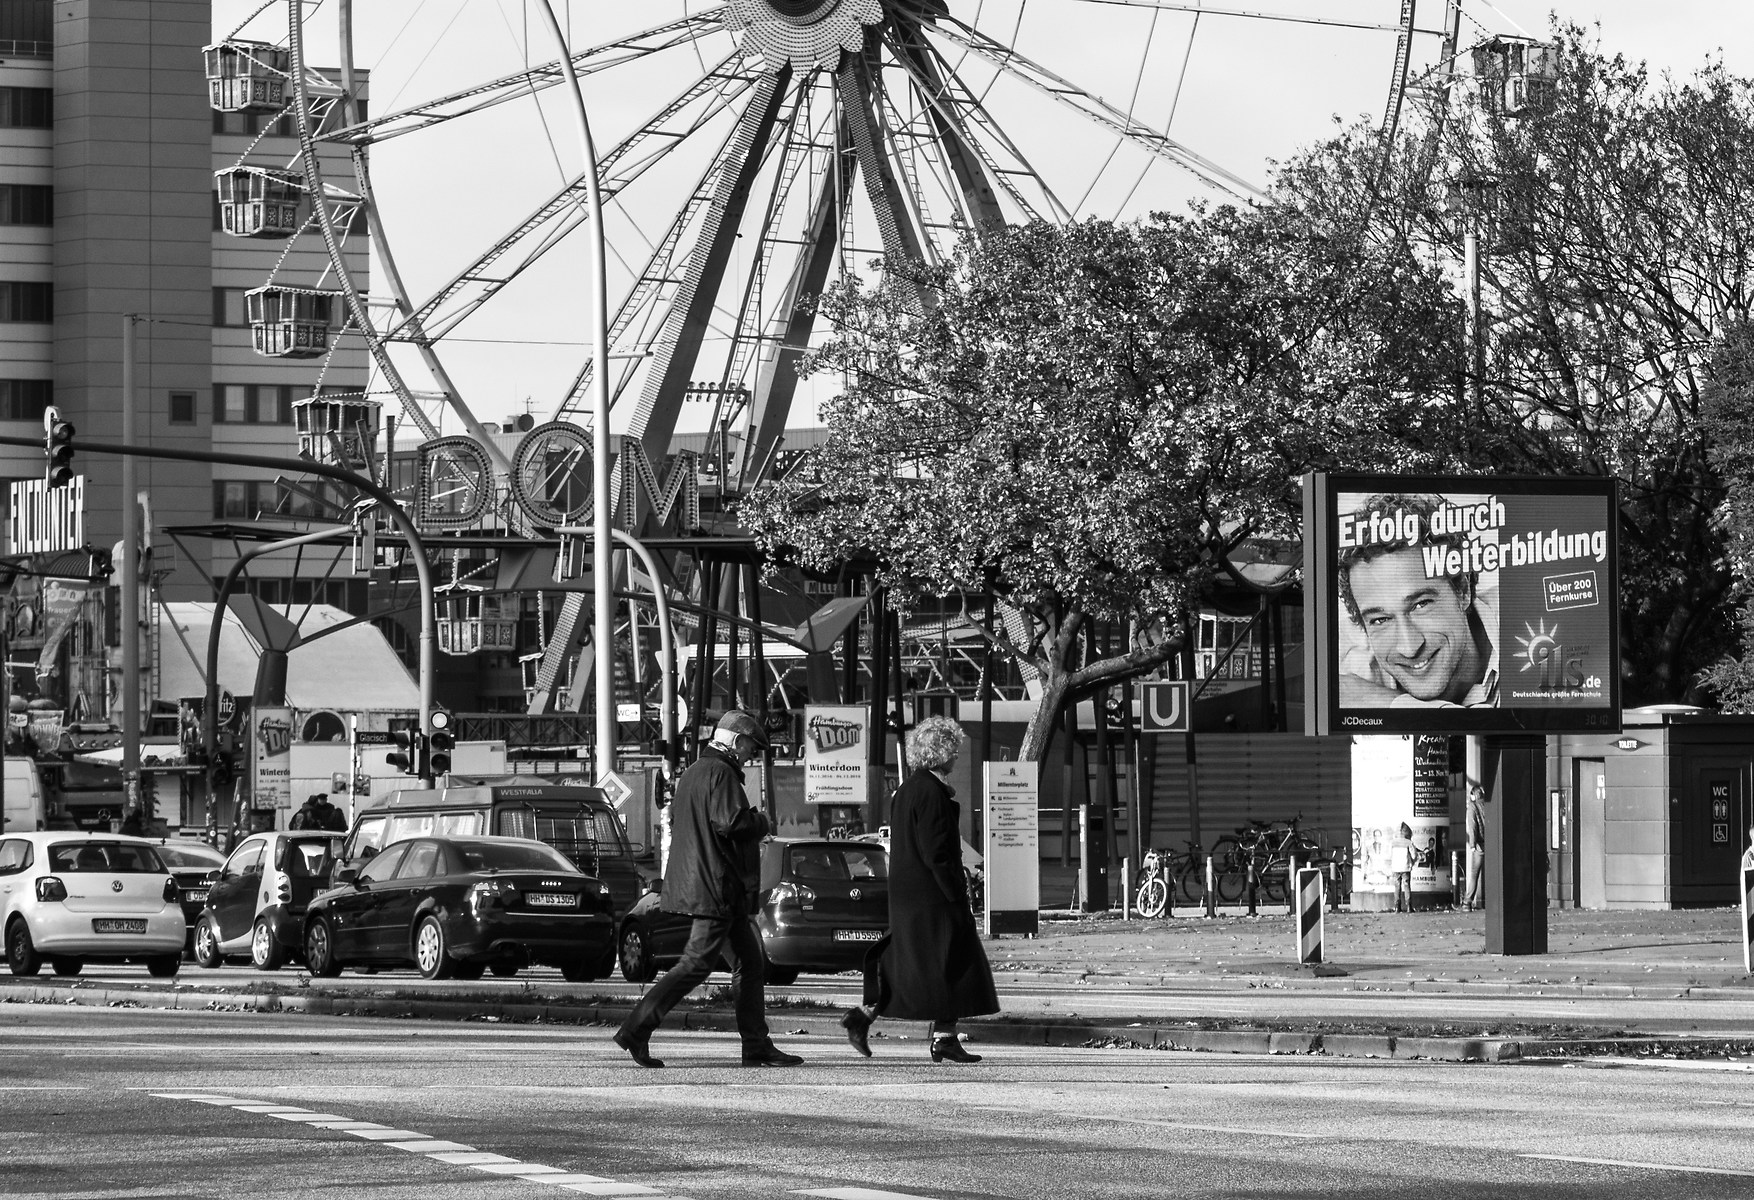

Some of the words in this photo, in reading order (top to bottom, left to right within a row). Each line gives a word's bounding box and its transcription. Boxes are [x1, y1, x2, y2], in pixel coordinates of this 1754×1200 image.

[10, 474, 84, 555] ENCOUNTER
[1339, 508, 1419, 548] Erfolg
[1430, 495, 1505, 535] durch
[1422, 528, 1607, 578] Weiterbildung
[1549, 582, 1571, 593] Über
[1574, 579, 1592, 590] 200
[1550, 590, 1593, 603] Fernkurse
[221, 698, 233, 713] ritz
[1150, 687, 1179, 727] U
[812, 715, 853, 728] Hamburger
[1342, 716, 1383, 725] JCDecaux
[267, 728, 290, 752] DO
[360, 734, 388, 742] Glacisch
[260, 768, 290, 776] Winterdo
[809, 764, 861, 772] Winterdom
[1712, 786, 1728, 796] WC
